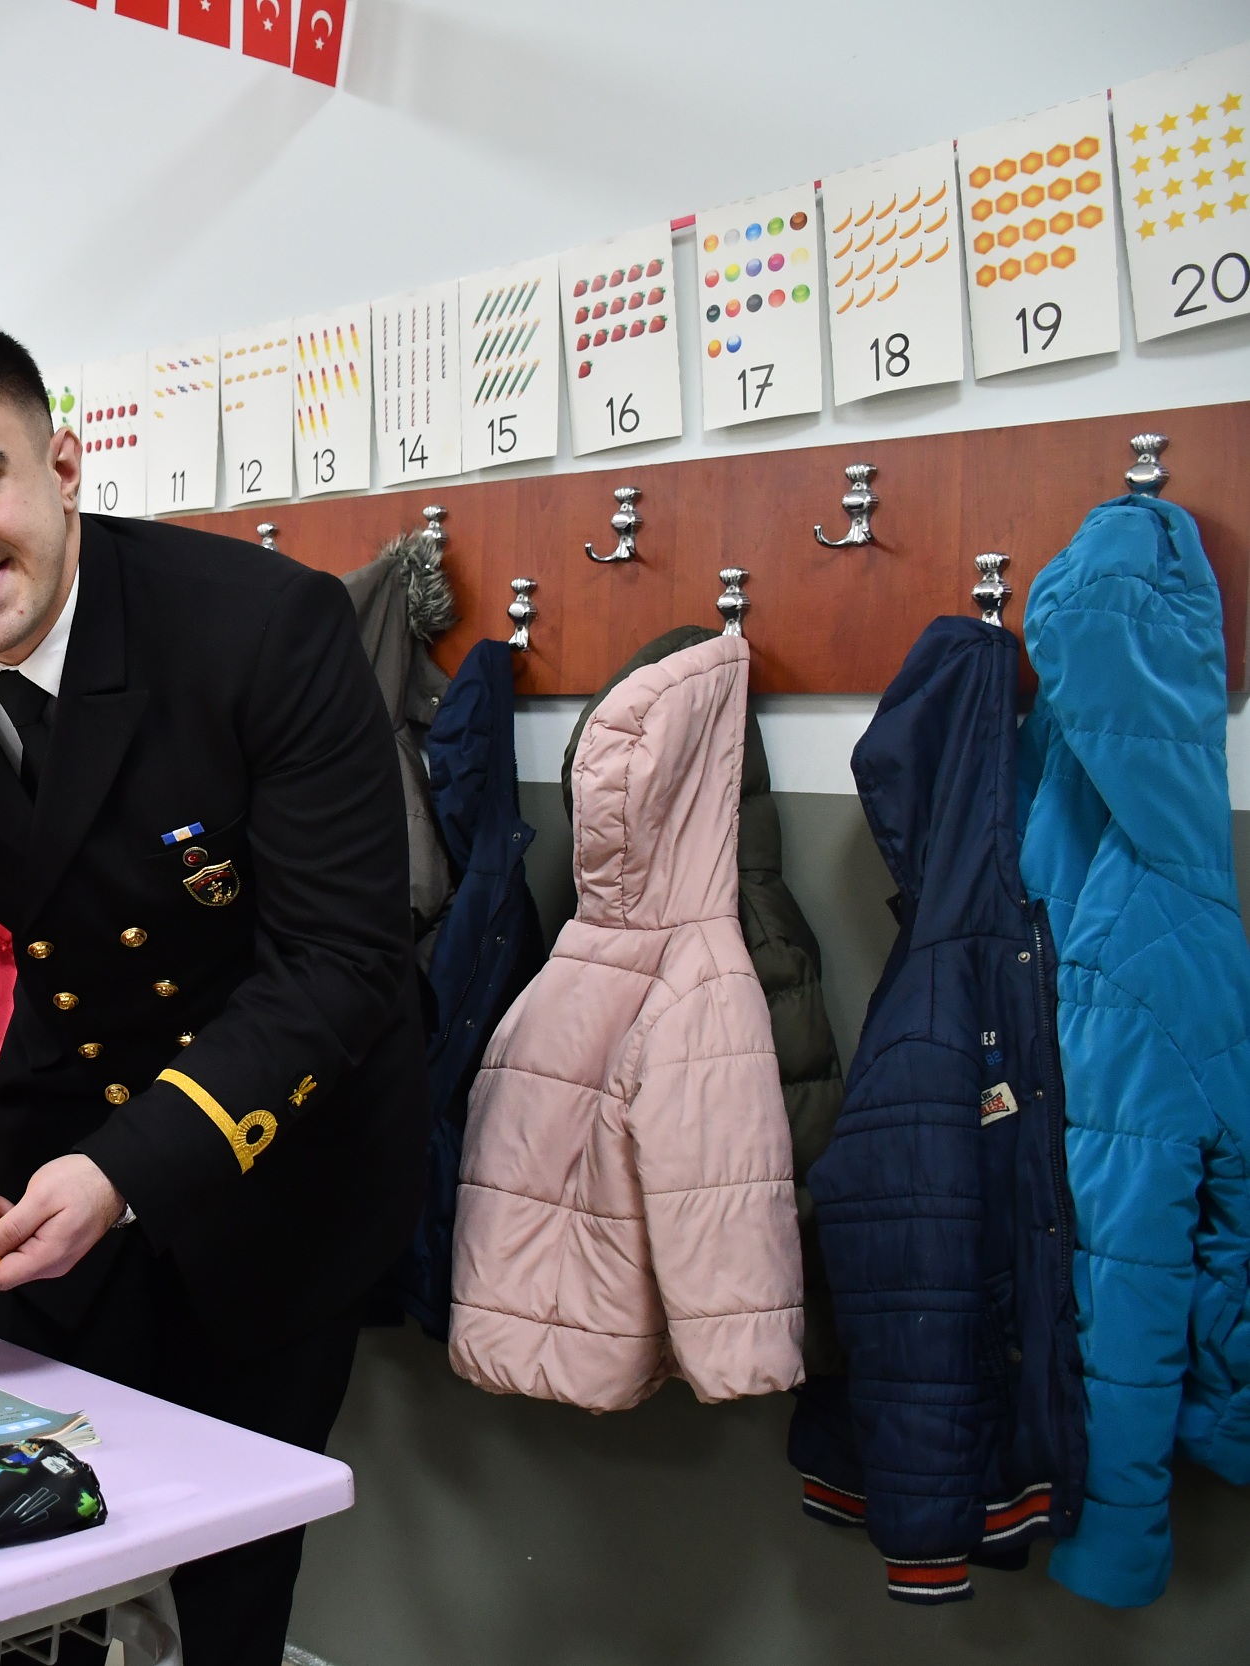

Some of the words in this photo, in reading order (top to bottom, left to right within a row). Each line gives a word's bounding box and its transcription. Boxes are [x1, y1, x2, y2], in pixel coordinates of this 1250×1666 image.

[1171, 252, 1250, 318] 20
[1015, 301, 1063, 355] 19
[869, 332, 911, 382] 18
[737, 363, 775, 411] 17
[487, 413, 518, 456] 15
[605, 392, 640, 437] 16
[312, 448, 336, 485] 13
[398, 433, 429, 473] 14
[96, 481, 119, 512] 10
[171, 470, 186, 502] 11
[239, 459, 264, 494] 12
